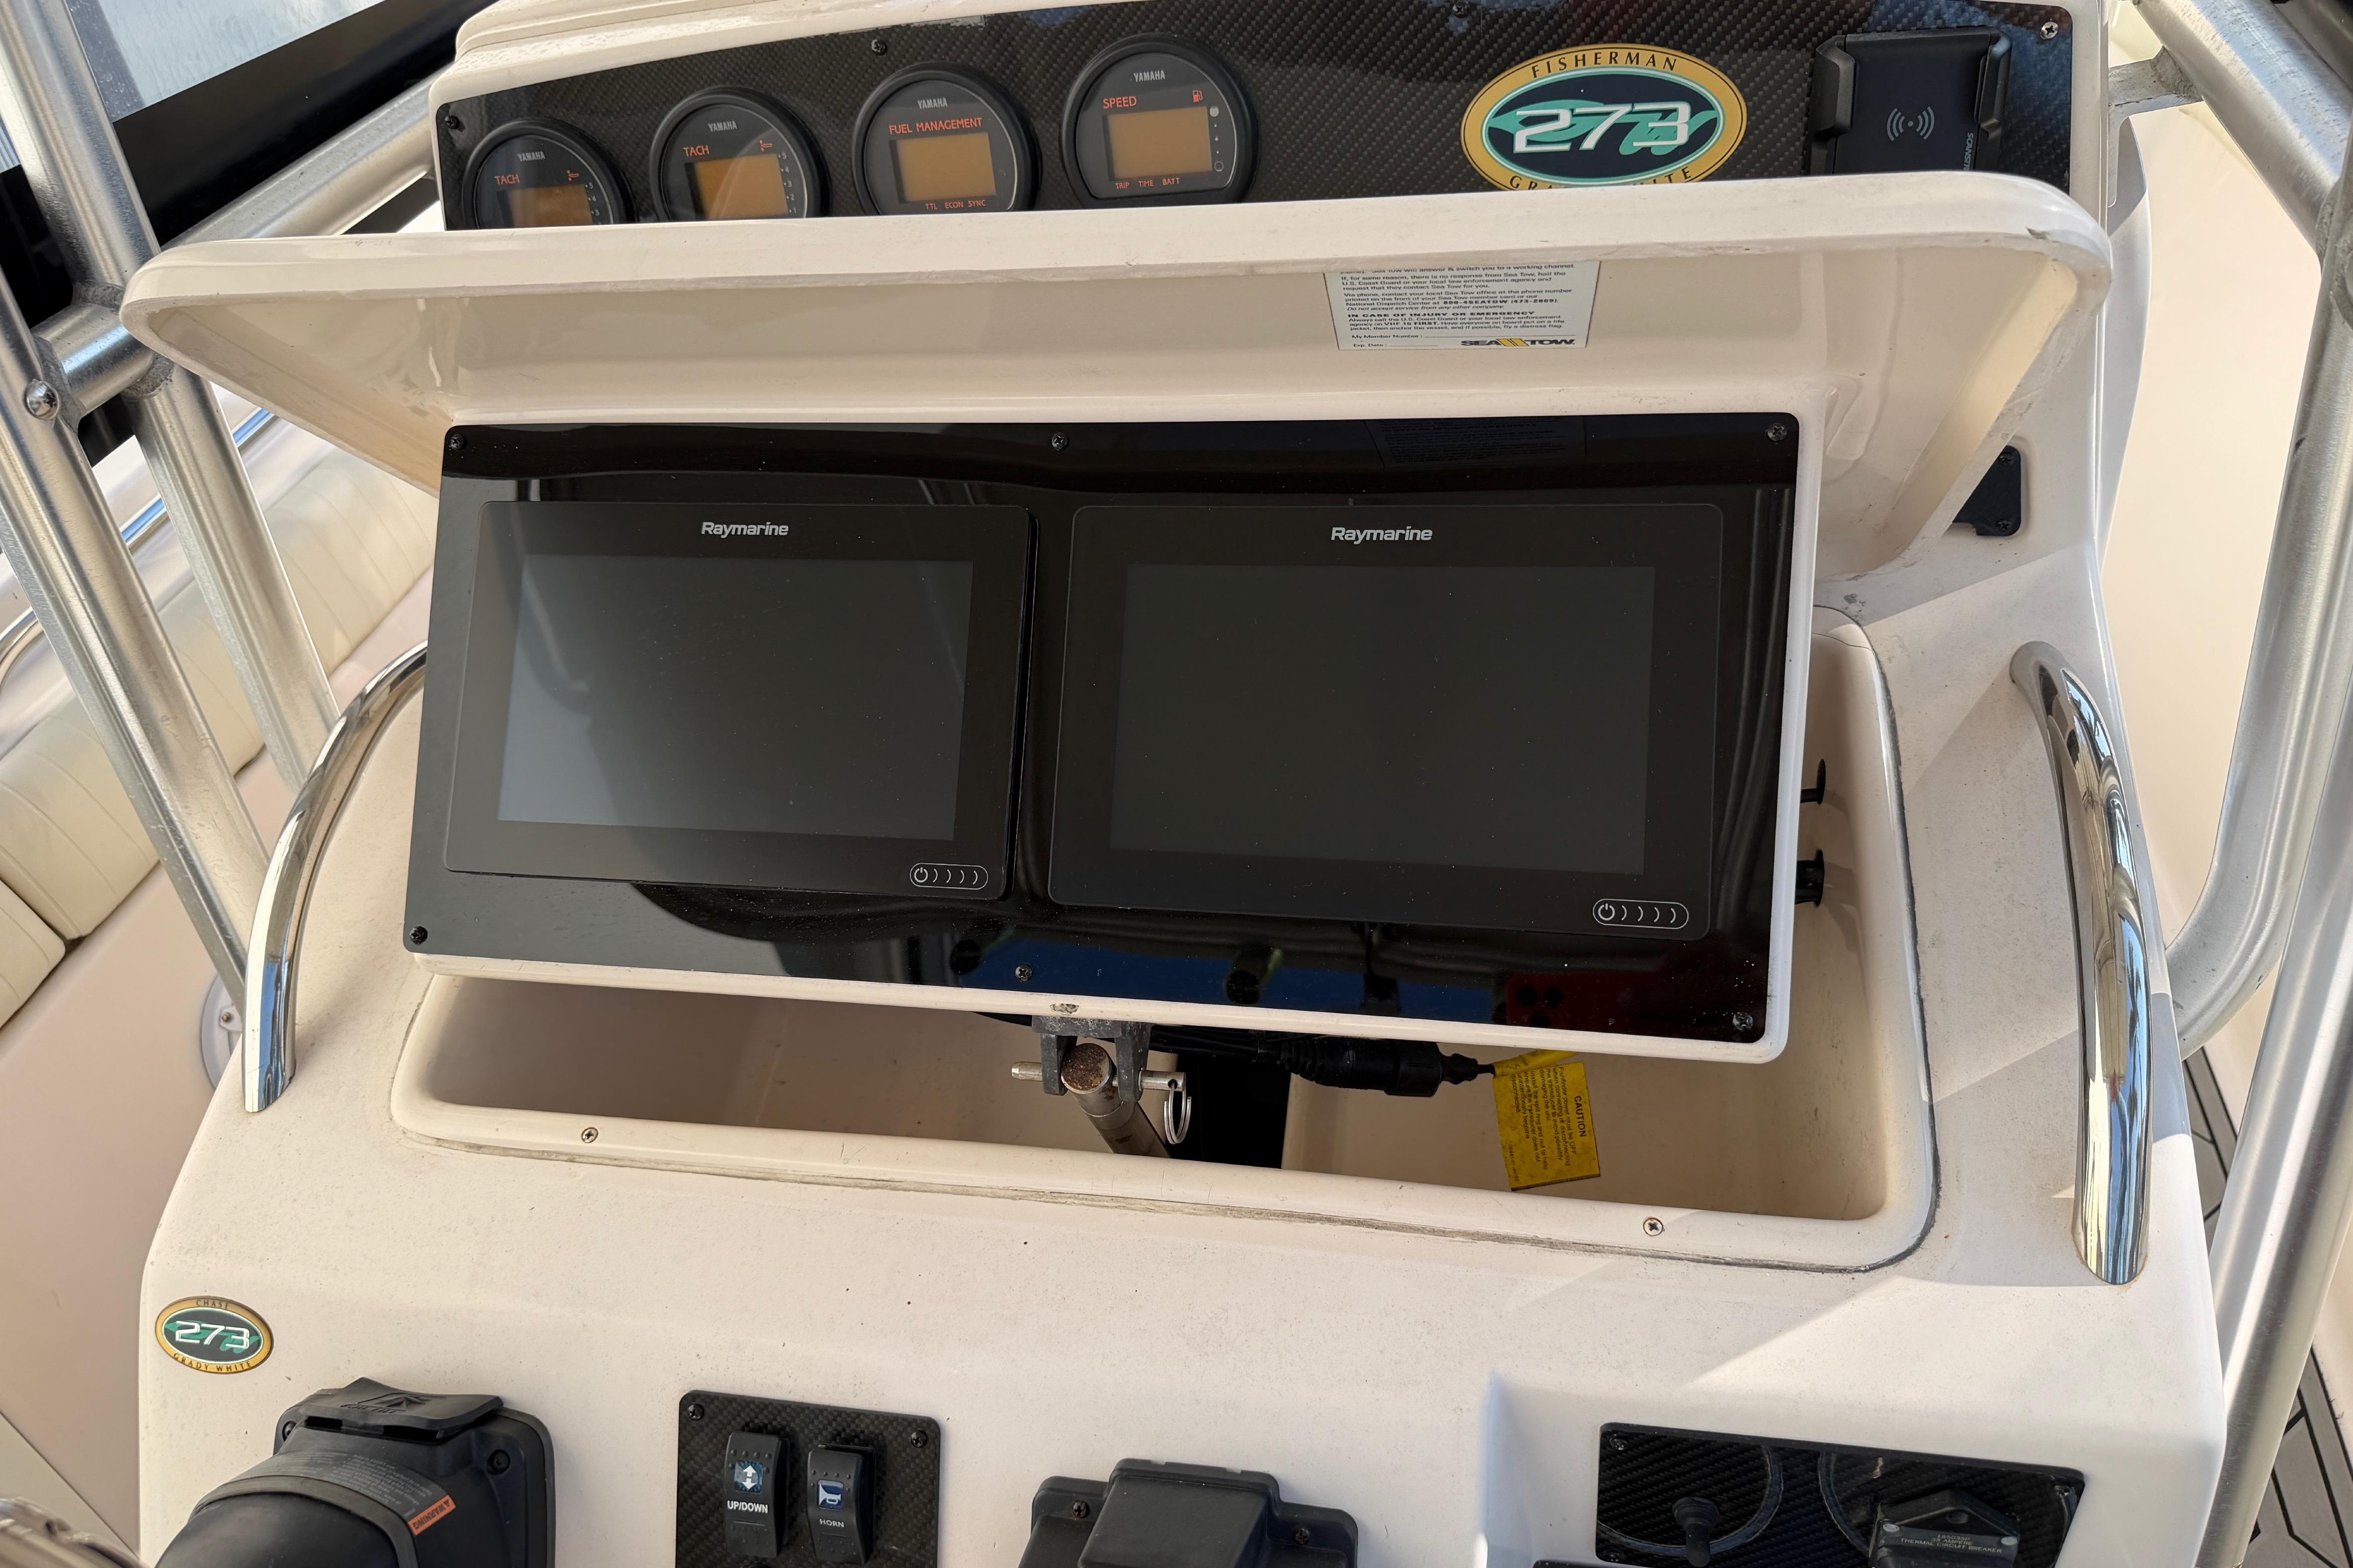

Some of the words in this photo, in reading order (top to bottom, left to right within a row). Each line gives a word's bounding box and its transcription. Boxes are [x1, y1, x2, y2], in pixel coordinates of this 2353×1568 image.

[1532, 51, 1677, 78] FISHERMAN
[1133, 71, 1165, 82] YAMAHA
[917, 98, 948, 109] YAMAHA
[1103, 96, 1137, 109] SPEED
[708, 120, 737, 132] YAMAHA
[889, 123, 913, 135] FUEL
[916, 117, 983, 132] MANAGEMENT
[1513, 102, 1692, 154] 273
[518, 151, 545, 162] YAMAHA
[683, 145, 710, 157] TACH
[494, 174, 520, 185] TACH
[1162, 177, 1180, 186] BATT
[701, 522, 789, 538] Raymarine
[1331, 526, 1432, 544] Raymarine
[1539, 1070, 1548, 1099] damaging
[1547, 1079, 1556, 1110] transducer
[1555, 1136, 1563, 1160] possibly
[1574, 1096, 1586, 1137] CAUTION
[1554, 1085, 1564, 1116] connecting
[1560, 1125, 1571, 1166] disconnecting
[197, 1300, 228, 1309] CHASE
[175, 1320, 249, 1349] 273
[174, 1353, 210, 1371] GRADY
[216, 1362, 251, 1372] WHITE
[727, 1500, 768, 1513] UP/DOWN
[412, 1504, 446, 1530] WARNING
[819, 1519, 844, 1528] HORN
